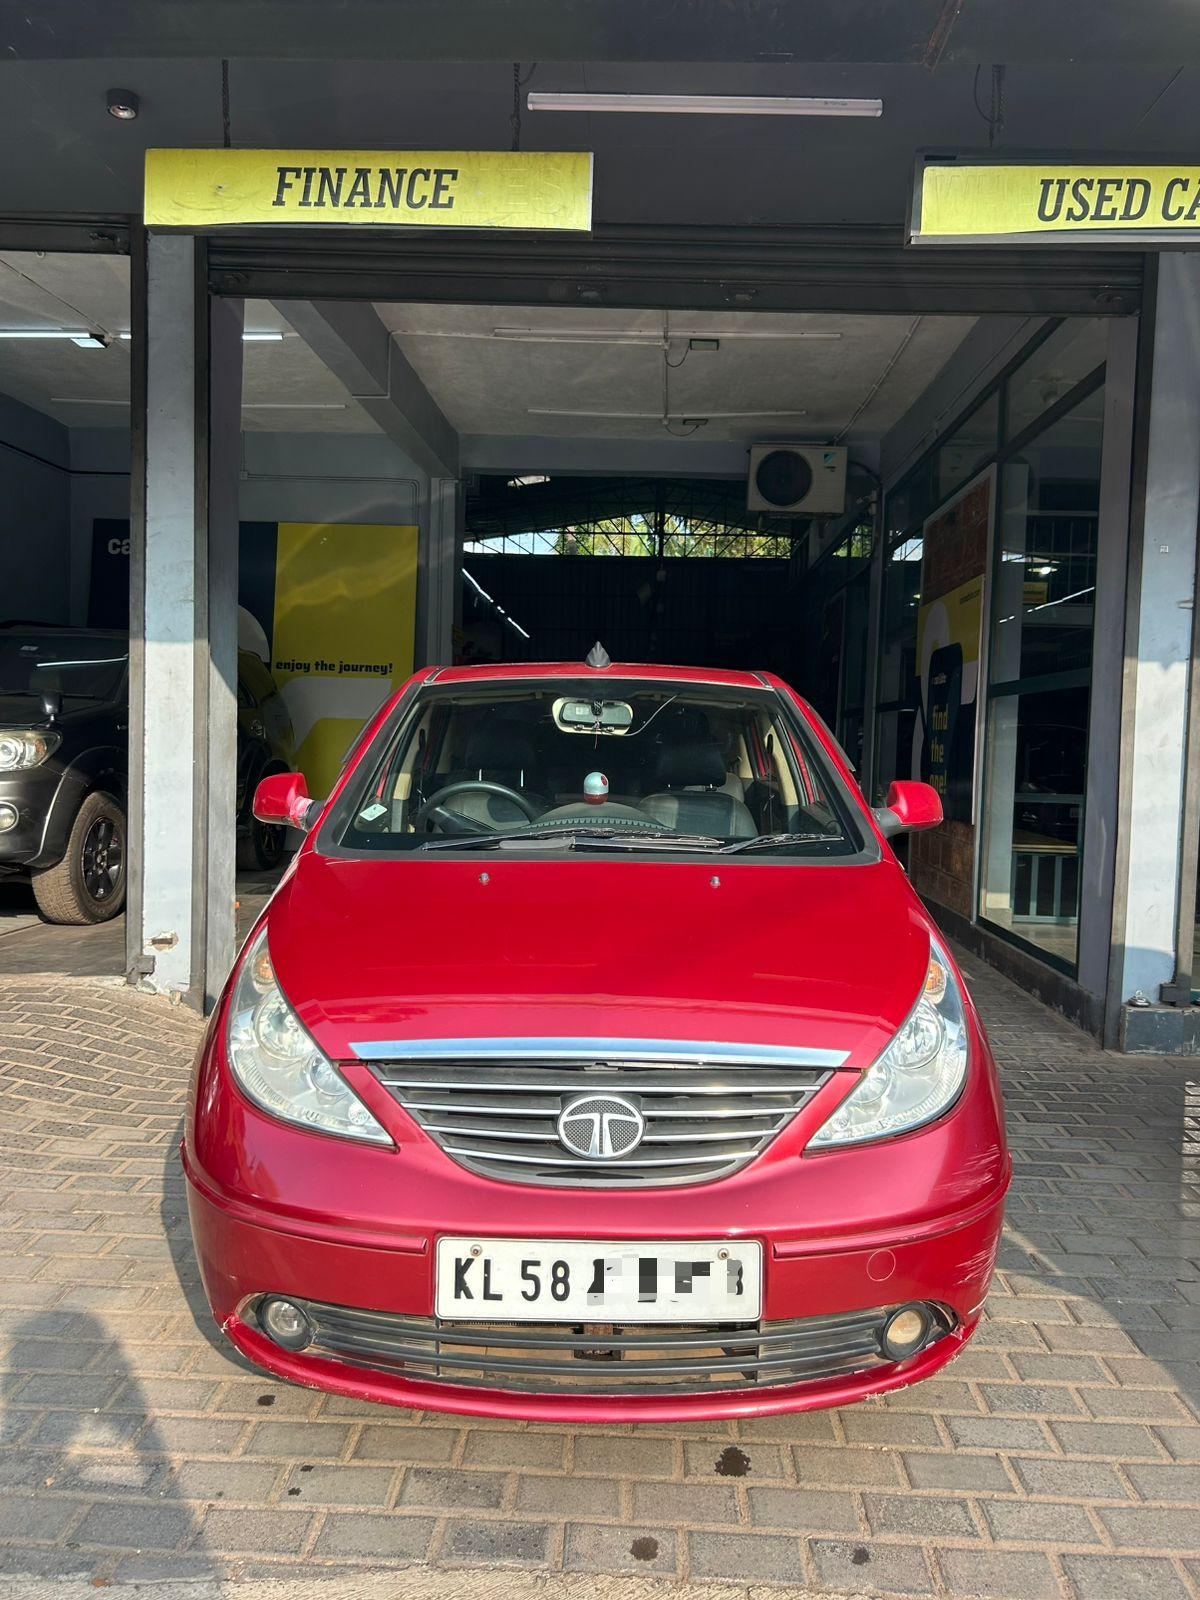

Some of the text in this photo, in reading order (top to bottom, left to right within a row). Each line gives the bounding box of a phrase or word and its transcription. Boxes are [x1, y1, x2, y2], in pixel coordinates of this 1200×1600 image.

[272, 166, 458, 209] FINANCE
[1037, 178, 1151, 221] USED
[276, 660, 393, 675] enjoy the journey!
[932, 704, 949, 731] find
[931, 736, 944, 763] the
[454, 1257, 503, 1301] KL
[521, 1259, 571, 1302] 58
